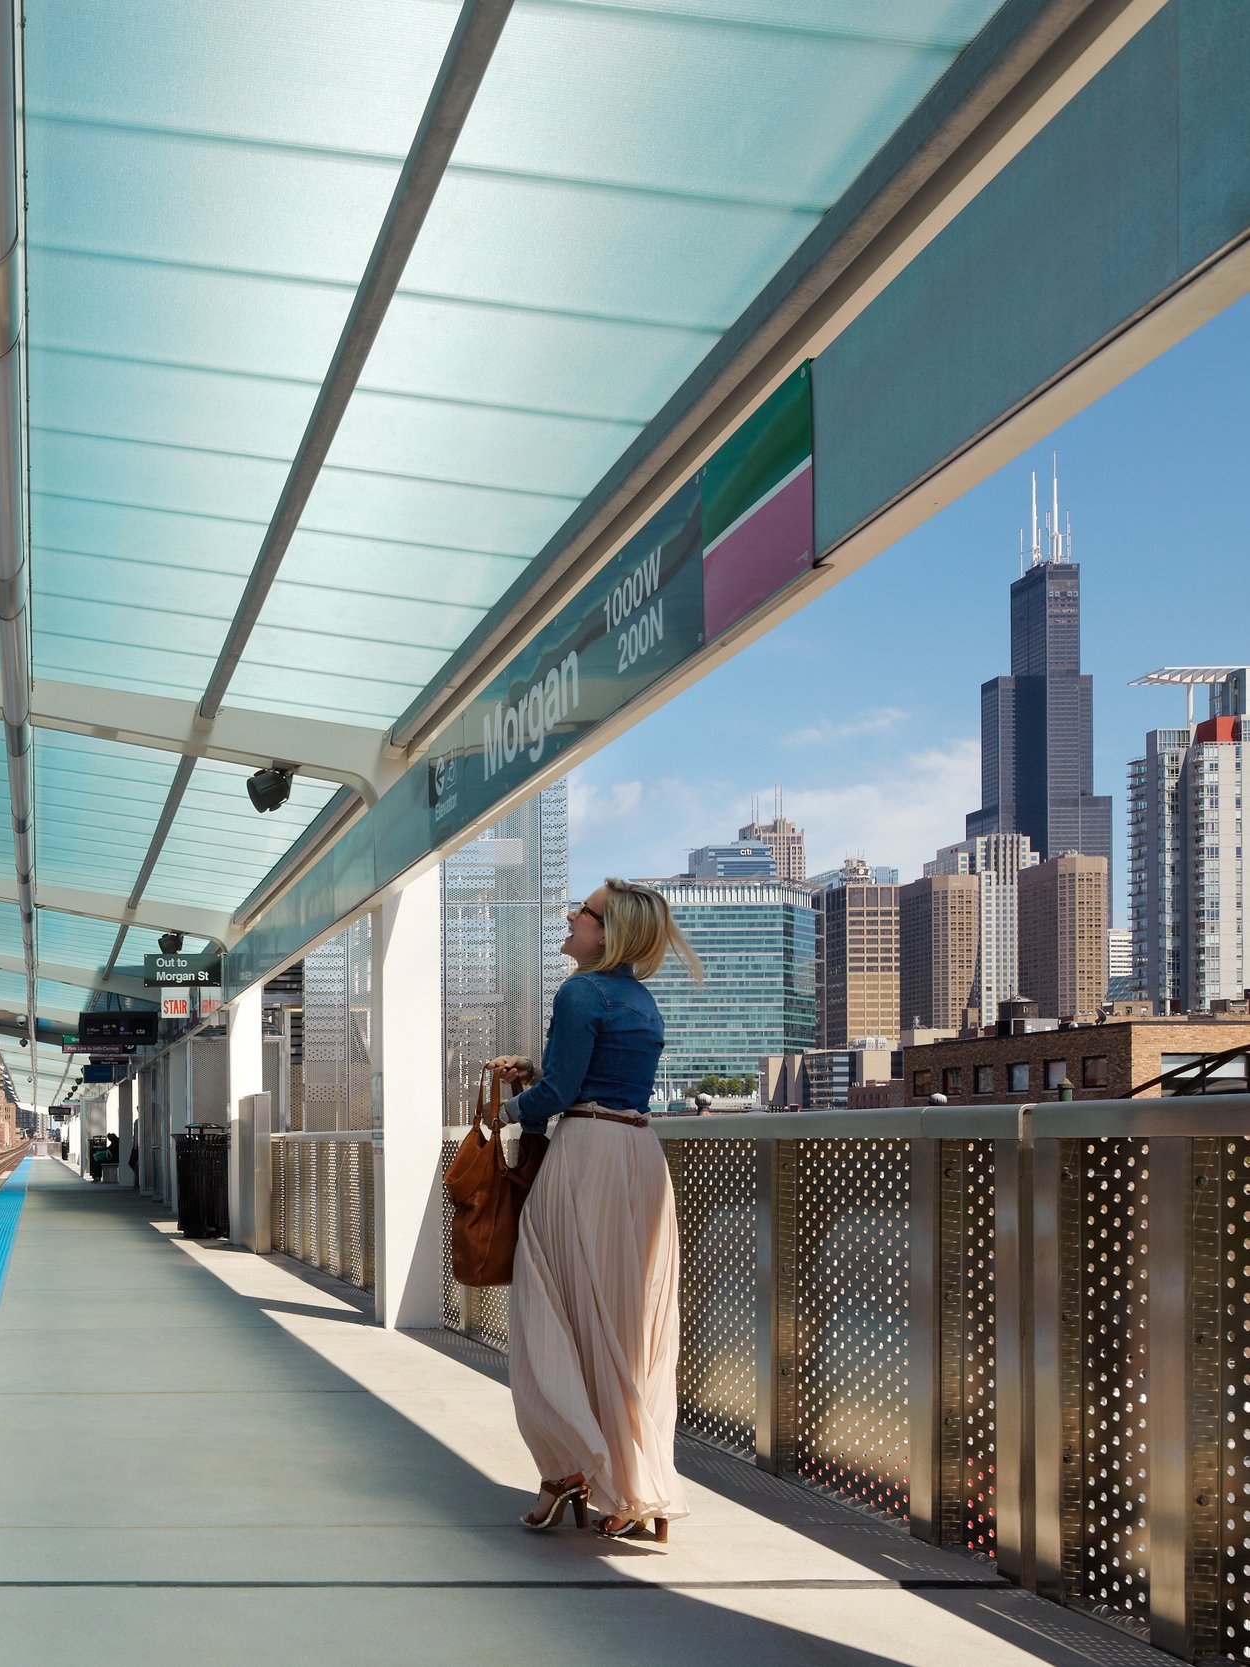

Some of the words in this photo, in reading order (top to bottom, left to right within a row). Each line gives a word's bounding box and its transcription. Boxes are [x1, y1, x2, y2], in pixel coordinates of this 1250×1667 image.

[603, 545, 661, 634] 1000W
[617, 598, 663, 674] 200N
[483, 650, 579, 782] Morgan
[435, 792, 458, 822] Elevator
[740, 848, 752, 856] citi
[156, 957, 175, 967] Out
[177, 958, 188, 967] to
[156, 971, 195, 983] Morgan
[197, 971, 209, 981] St
[163, 999, 187, 1014] STAIR
